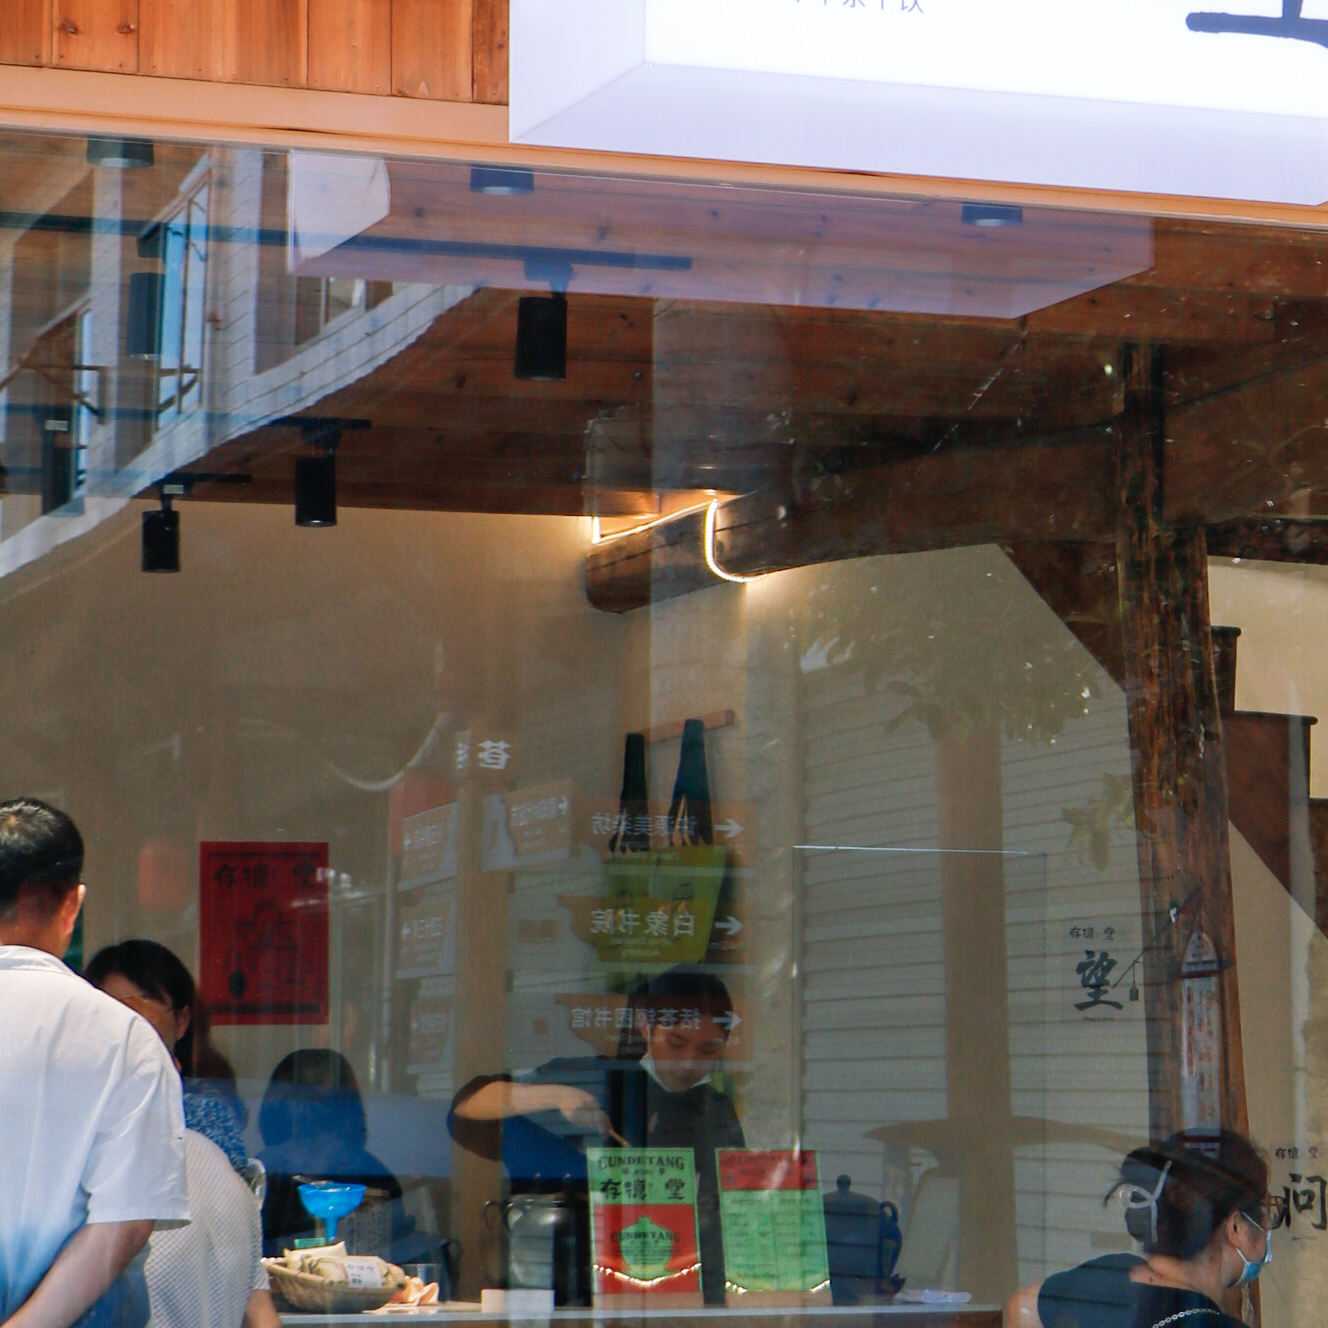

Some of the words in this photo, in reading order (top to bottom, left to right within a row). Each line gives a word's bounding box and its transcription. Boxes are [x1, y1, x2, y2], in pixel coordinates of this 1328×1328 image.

[1074, 949, 1124, 1011] 望
[598, 1155, 685, 1170] CUNDETANG
[1281, 1172, 1328, 1230] 问
